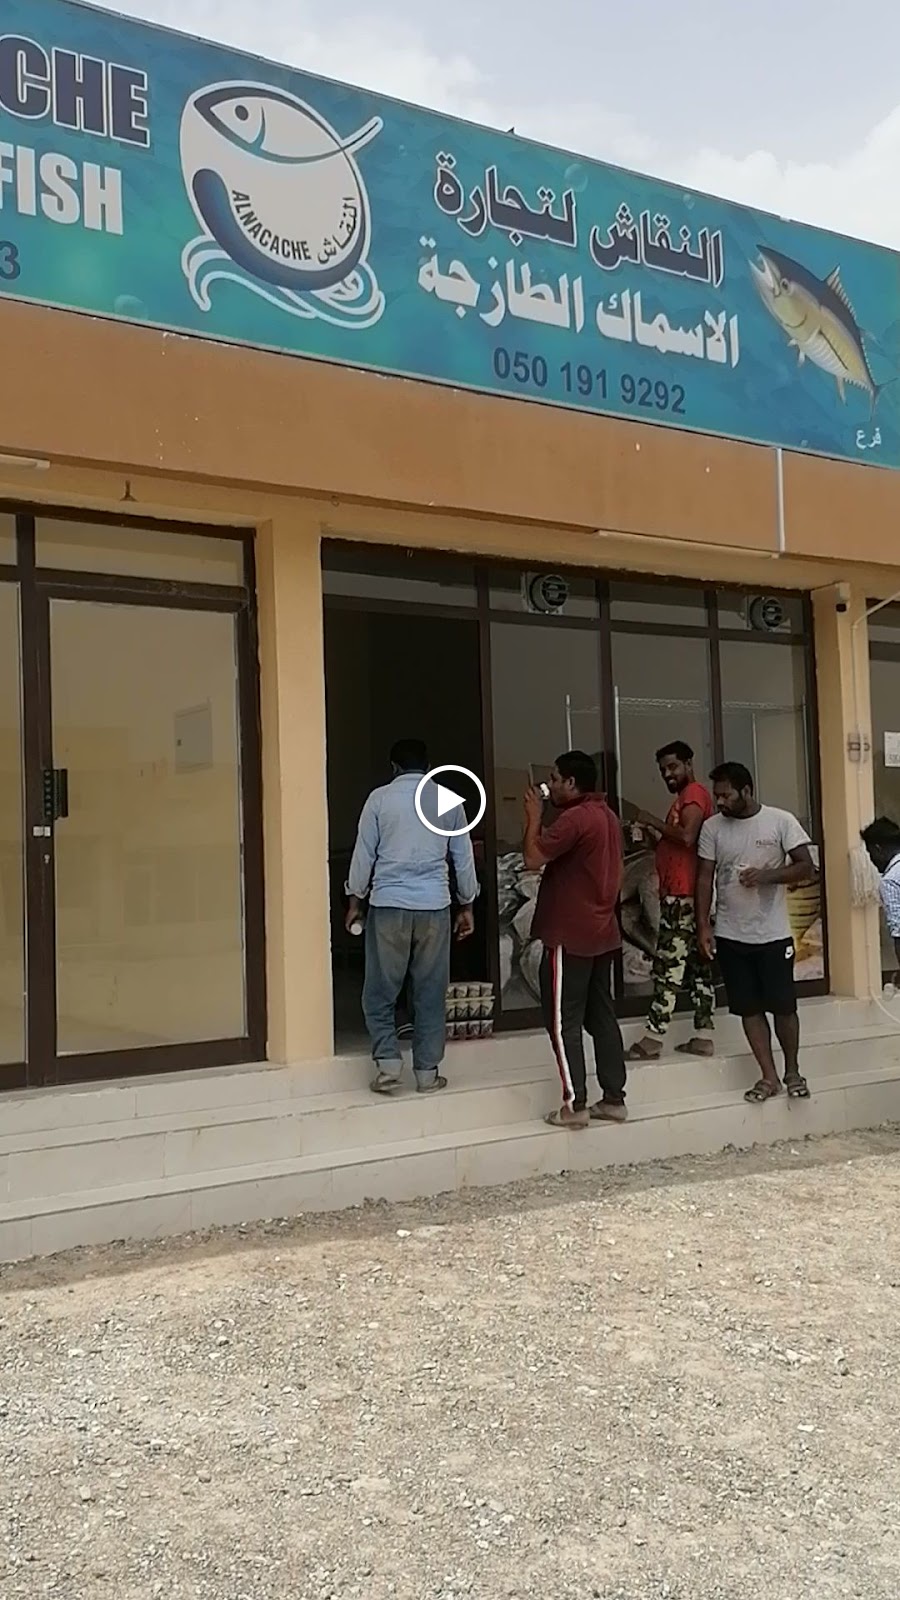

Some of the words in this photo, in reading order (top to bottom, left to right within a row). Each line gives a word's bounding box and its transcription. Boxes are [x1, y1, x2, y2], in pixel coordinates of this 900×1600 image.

[0, 34, 150, 148] CHE
[231, 189, 311, 261] ALNACACHE
[317, 197, 358, 265] النقاش
[434, 151, 577, 247] لتجارة
[418, 235, 585, 334] الطازجة
[589, 202, 724, 289] النقاش
[596, 288, 739, 369] الاسماك
[493, 346, 548, 387] 050
[560, 361, 608, 400] 191
[620, 373, 686, 415] 9292
[855, 427, 881, 450] فرع
